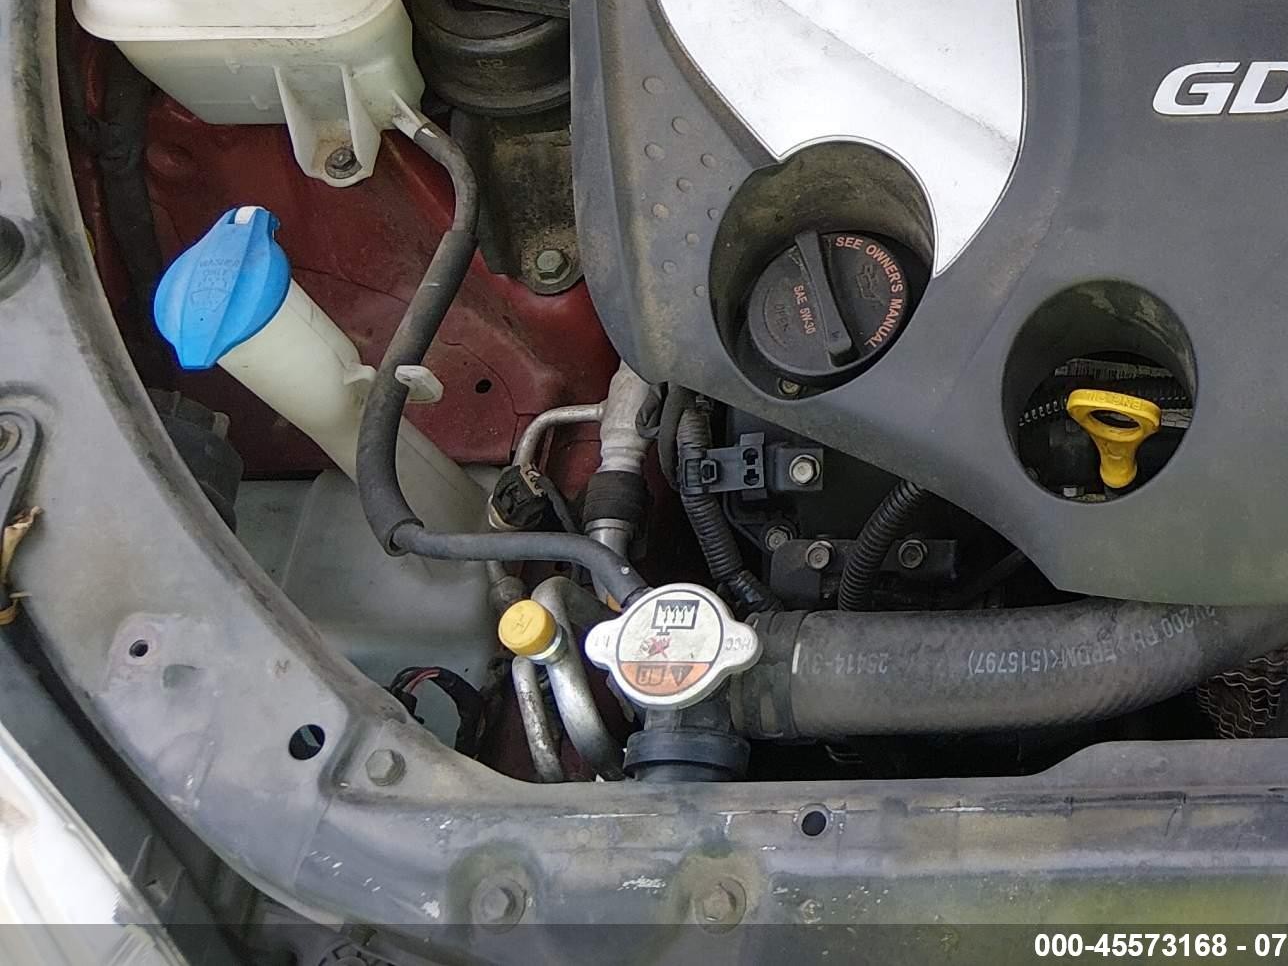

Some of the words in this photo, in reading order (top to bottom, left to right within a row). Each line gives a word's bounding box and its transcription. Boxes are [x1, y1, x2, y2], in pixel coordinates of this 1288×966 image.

[835, 236, 864, 250] SEE
[865, 243, 904, 293] OWNER'S
[793, 285, 808, 305] SAE
[799, 307, 816, 335] 5W-30
[863, 298, 903, 348] MANUAL
